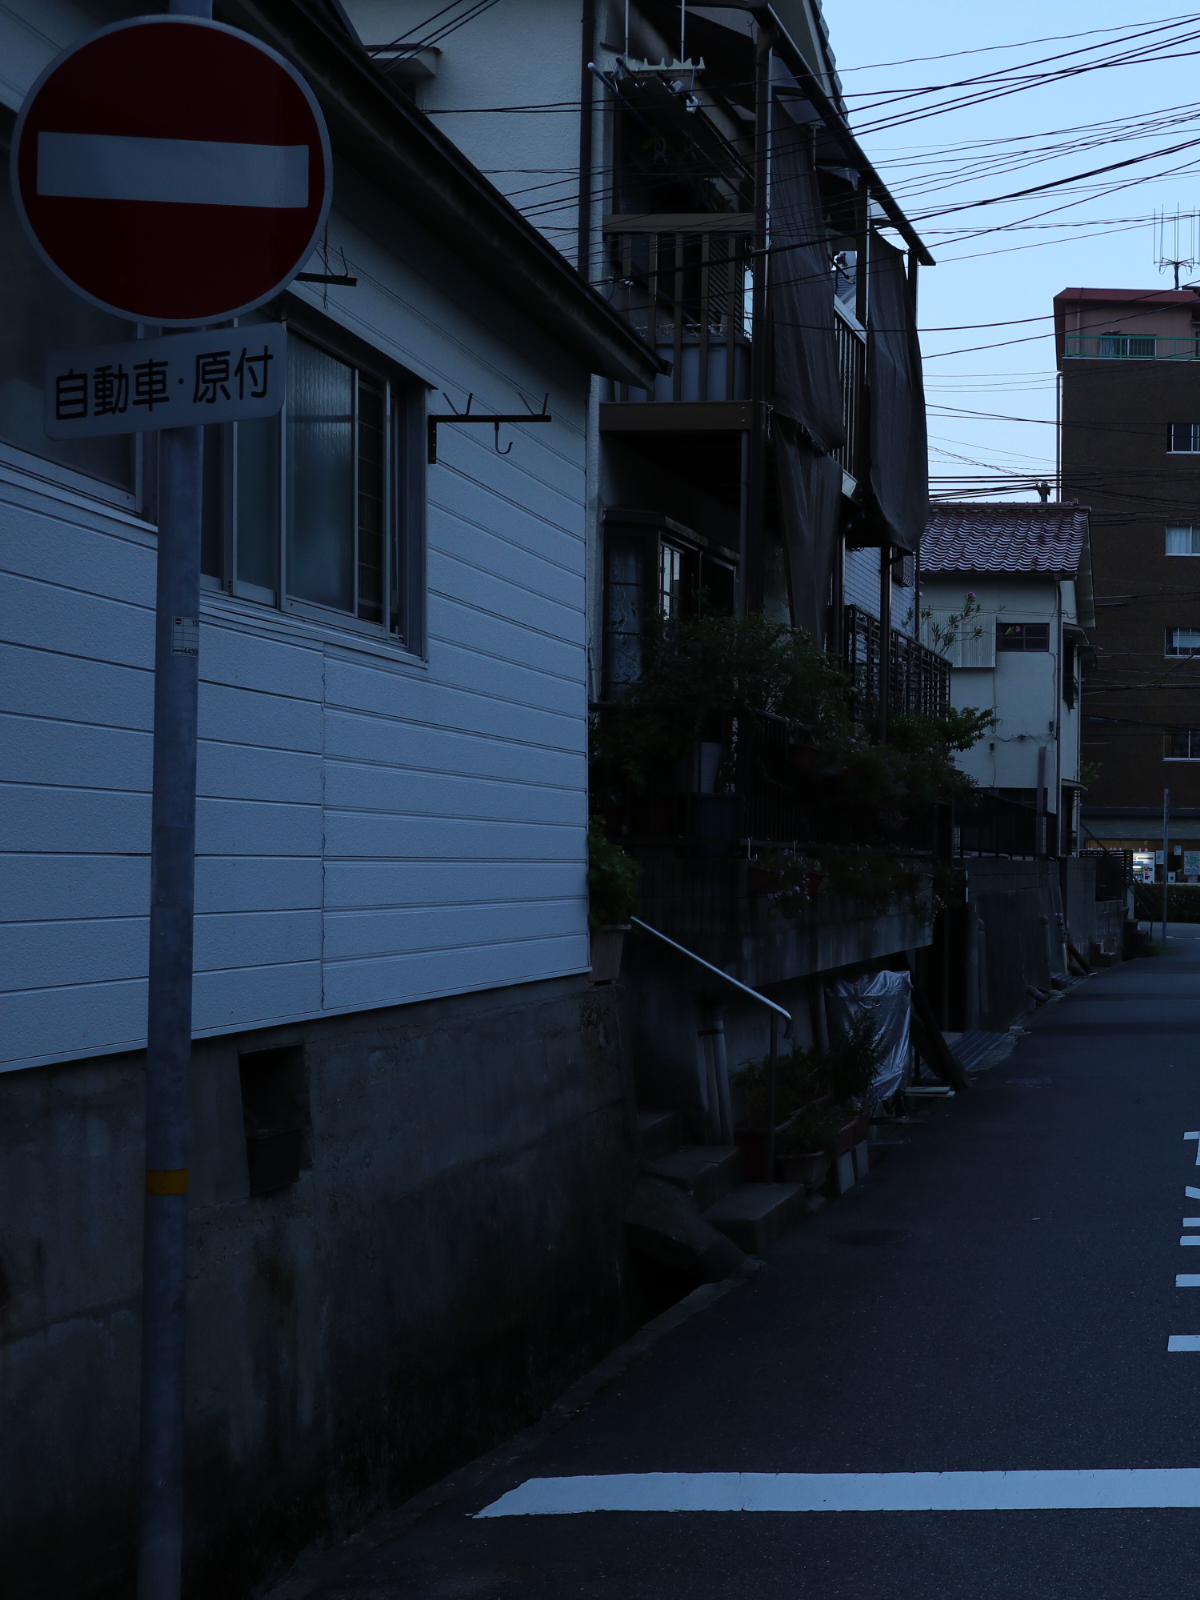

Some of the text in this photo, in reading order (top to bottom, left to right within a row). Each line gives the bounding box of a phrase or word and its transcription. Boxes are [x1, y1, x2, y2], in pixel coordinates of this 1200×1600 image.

[56, 345, 274, 421] 自動車・原付
